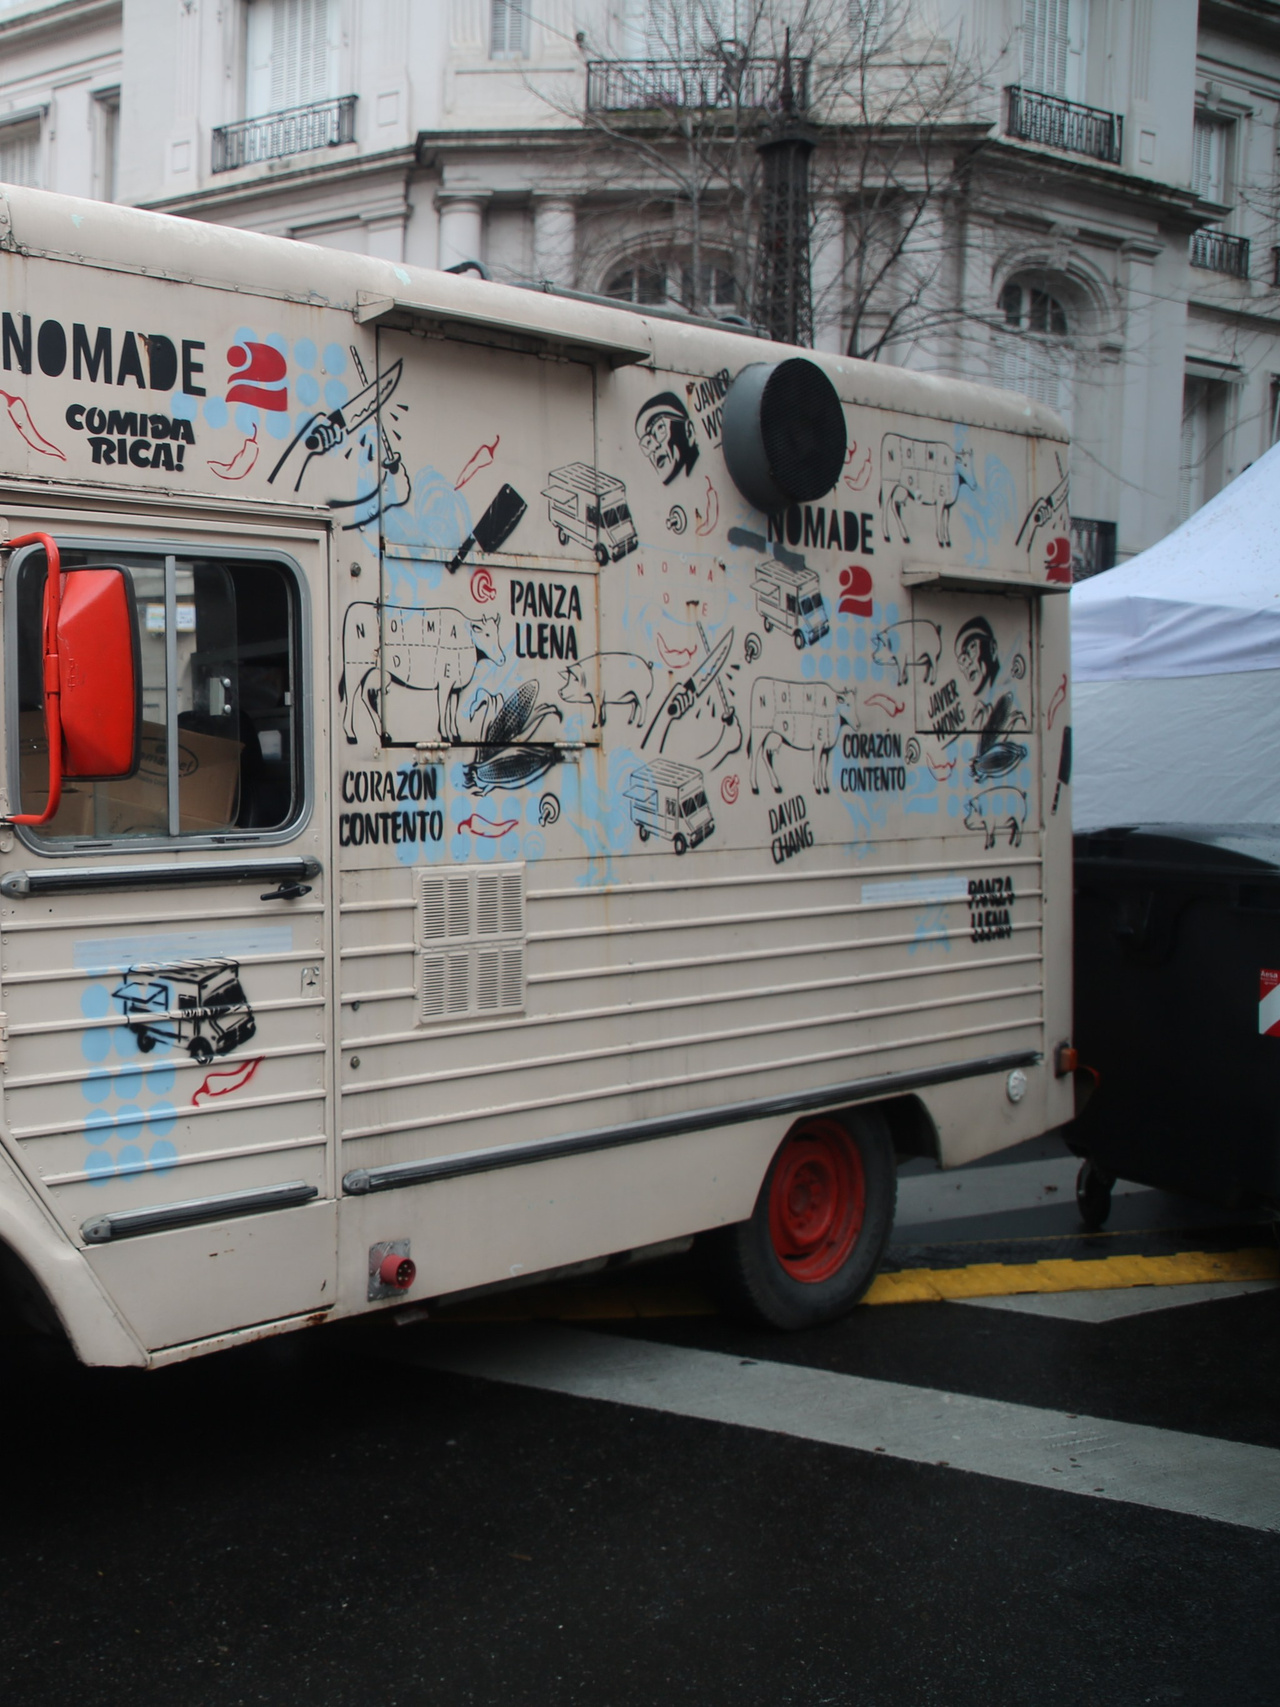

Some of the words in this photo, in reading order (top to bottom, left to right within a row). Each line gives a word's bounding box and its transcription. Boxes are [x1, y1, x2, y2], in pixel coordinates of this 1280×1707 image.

[2, 312, 206, 397] NOMADE
[225, 341, 287, 412] 2
[694, 368, 729, 412] JAVIER
[65, 404, 196, 445] COMIDA
[87, 437, 186, 472] RICA!
[767, 503, 875, 555] NOMADE
[510, 579, 582, 621] PANZA
[515, 622, 578, 661] LLENA
[928, 678, 960, 719] JAVIER
[341, 761, 438, 804] CORAZÓN
[840, 766, 907, 792] CONTENTO
[338, 809, 444, 847] CONTENTO
[768, 794, 807, 835] DAVID
[771, 821, 814, 865] CHANG
[967, 875, 1015, 911] PANZA
